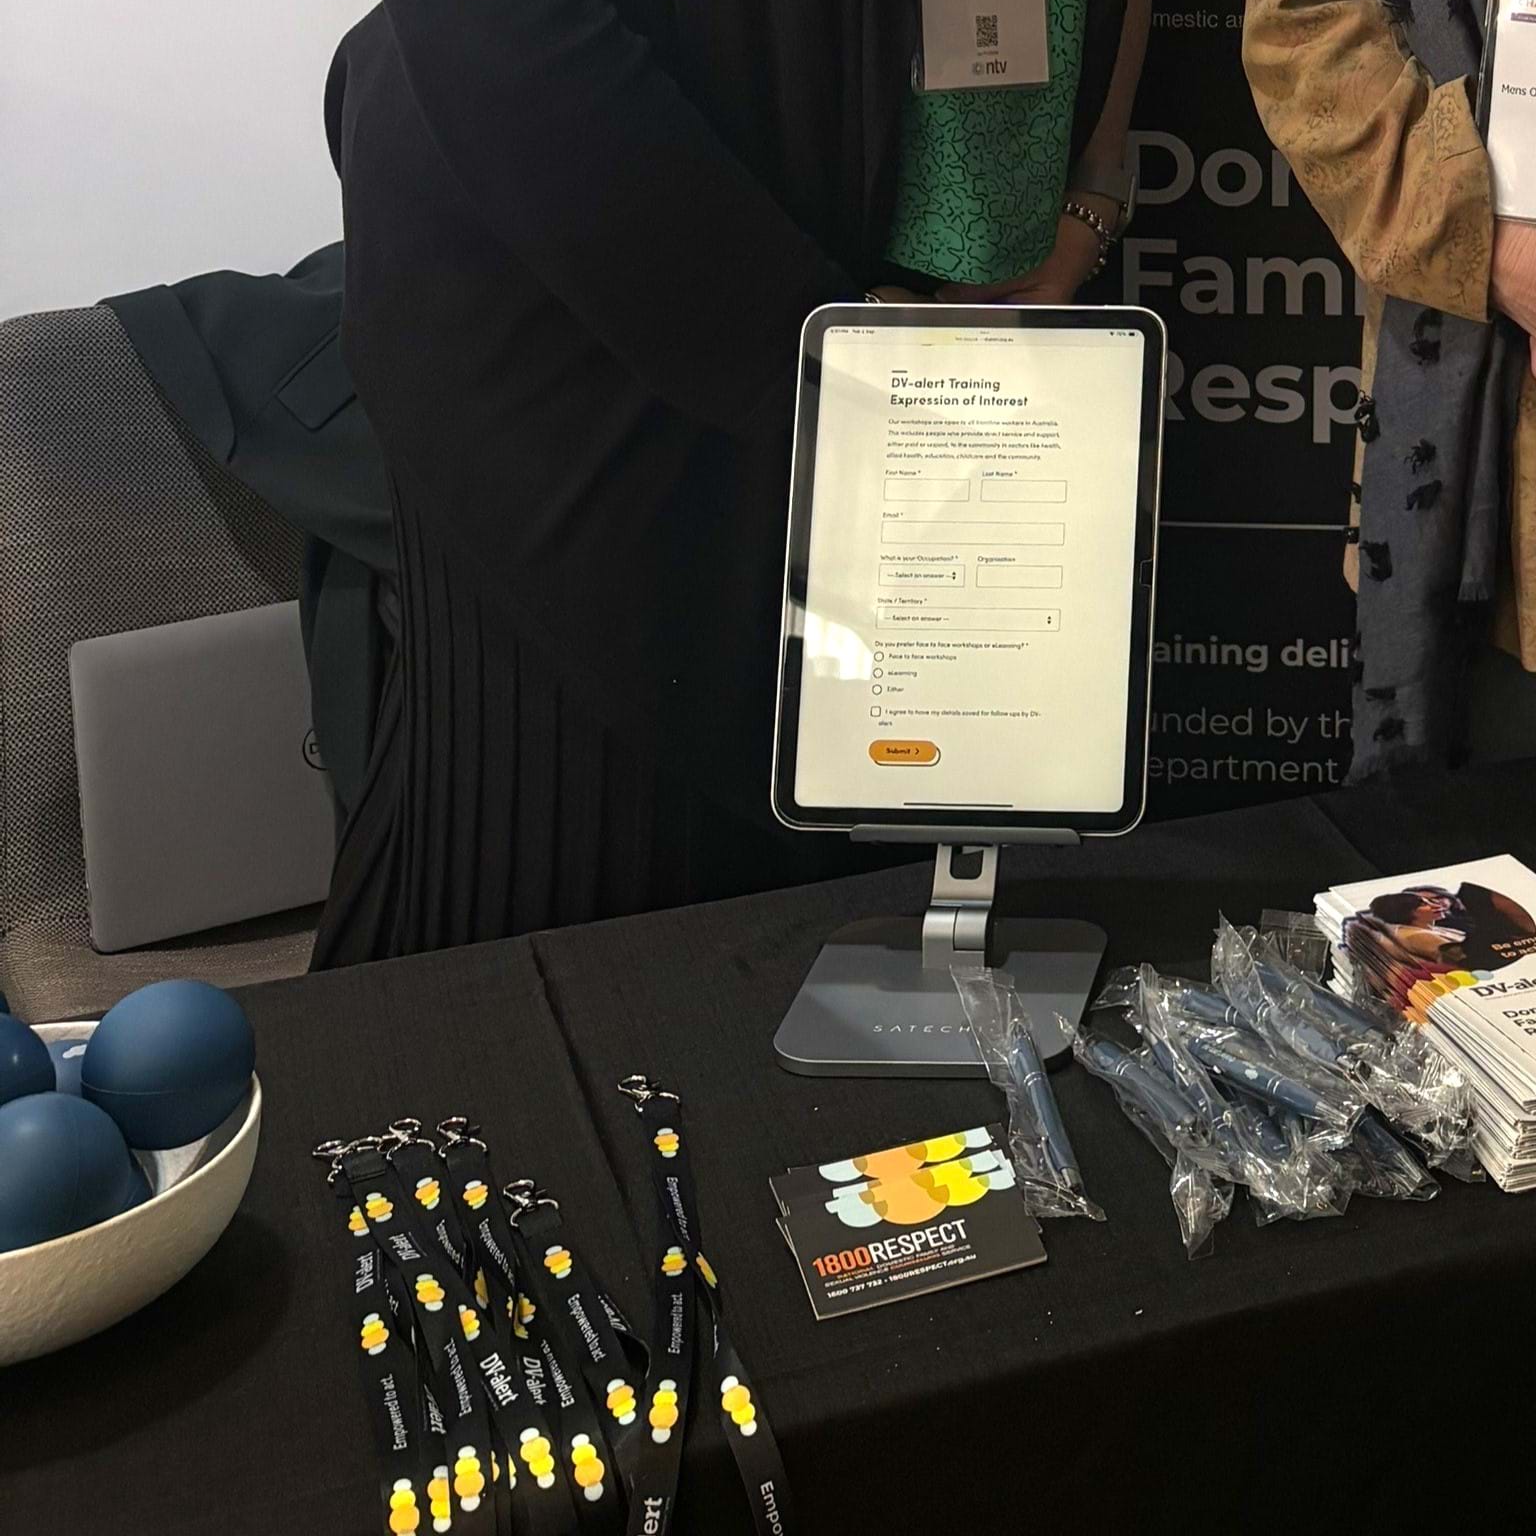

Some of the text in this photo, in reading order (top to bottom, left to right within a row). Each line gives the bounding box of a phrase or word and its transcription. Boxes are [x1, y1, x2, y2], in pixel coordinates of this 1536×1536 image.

[1152, 9, 1219, 30] mestic
[985, 59, 1008, 75] ntv
[1501, 83, 1527, 96] Mens
[890, 376, 1001, 393] DV-alert Training
[890, 394, 1028, 408] Expression of Interest
[1153, 633, 1269, 673] aining
[1266, 708, 1309, 744] by
[1149, 754, 1340, 785] epartment
[812, 1218, 968, 1277] 1800RESPECT
[479, 1351, 520, 1407] DV-alert
[760, 1479, 784, 1536] Empo
